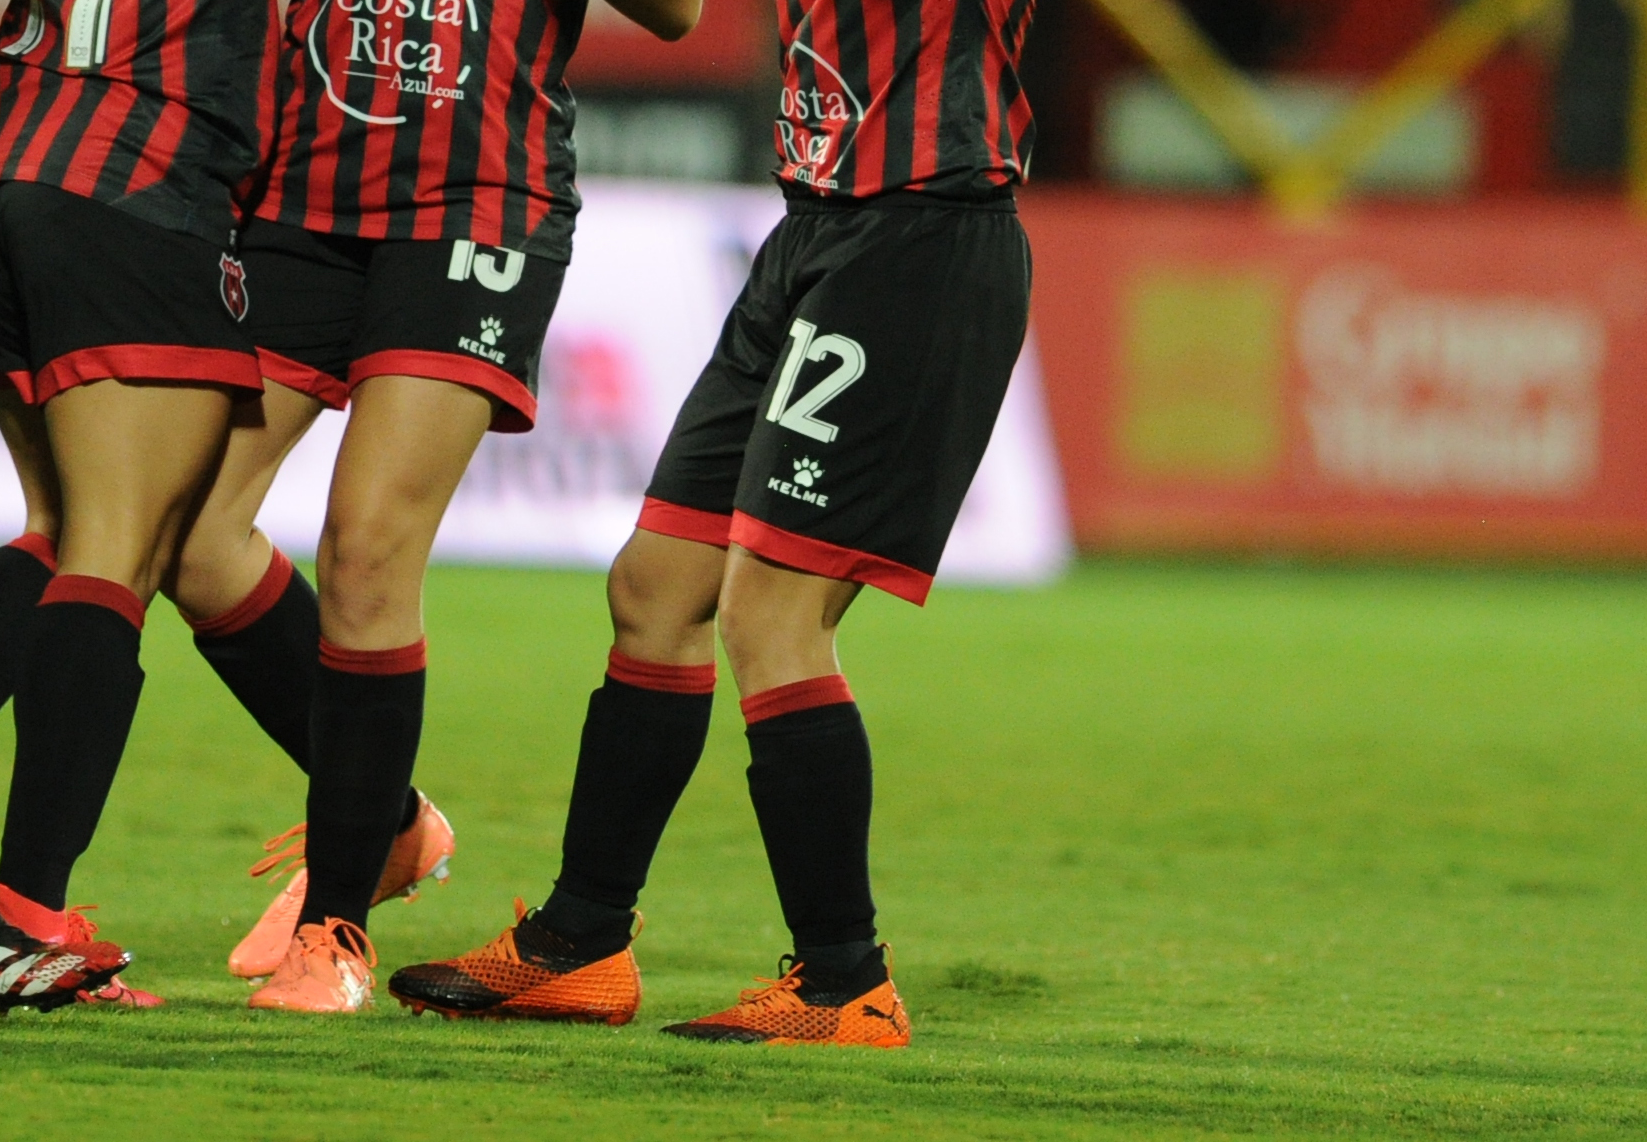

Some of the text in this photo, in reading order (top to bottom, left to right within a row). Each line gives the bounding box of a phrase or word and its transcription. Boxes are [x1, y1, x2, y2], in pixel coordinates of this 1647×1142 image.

[344, 16, 445, 75] Rica
[388, 70, 465, 101] Azul.com
[780, 85, 851, 122] osta
[457, 335, 507, 365] KELME
[765, 316, 867, 444] 12
[767, 476, 830, 508] KELME
